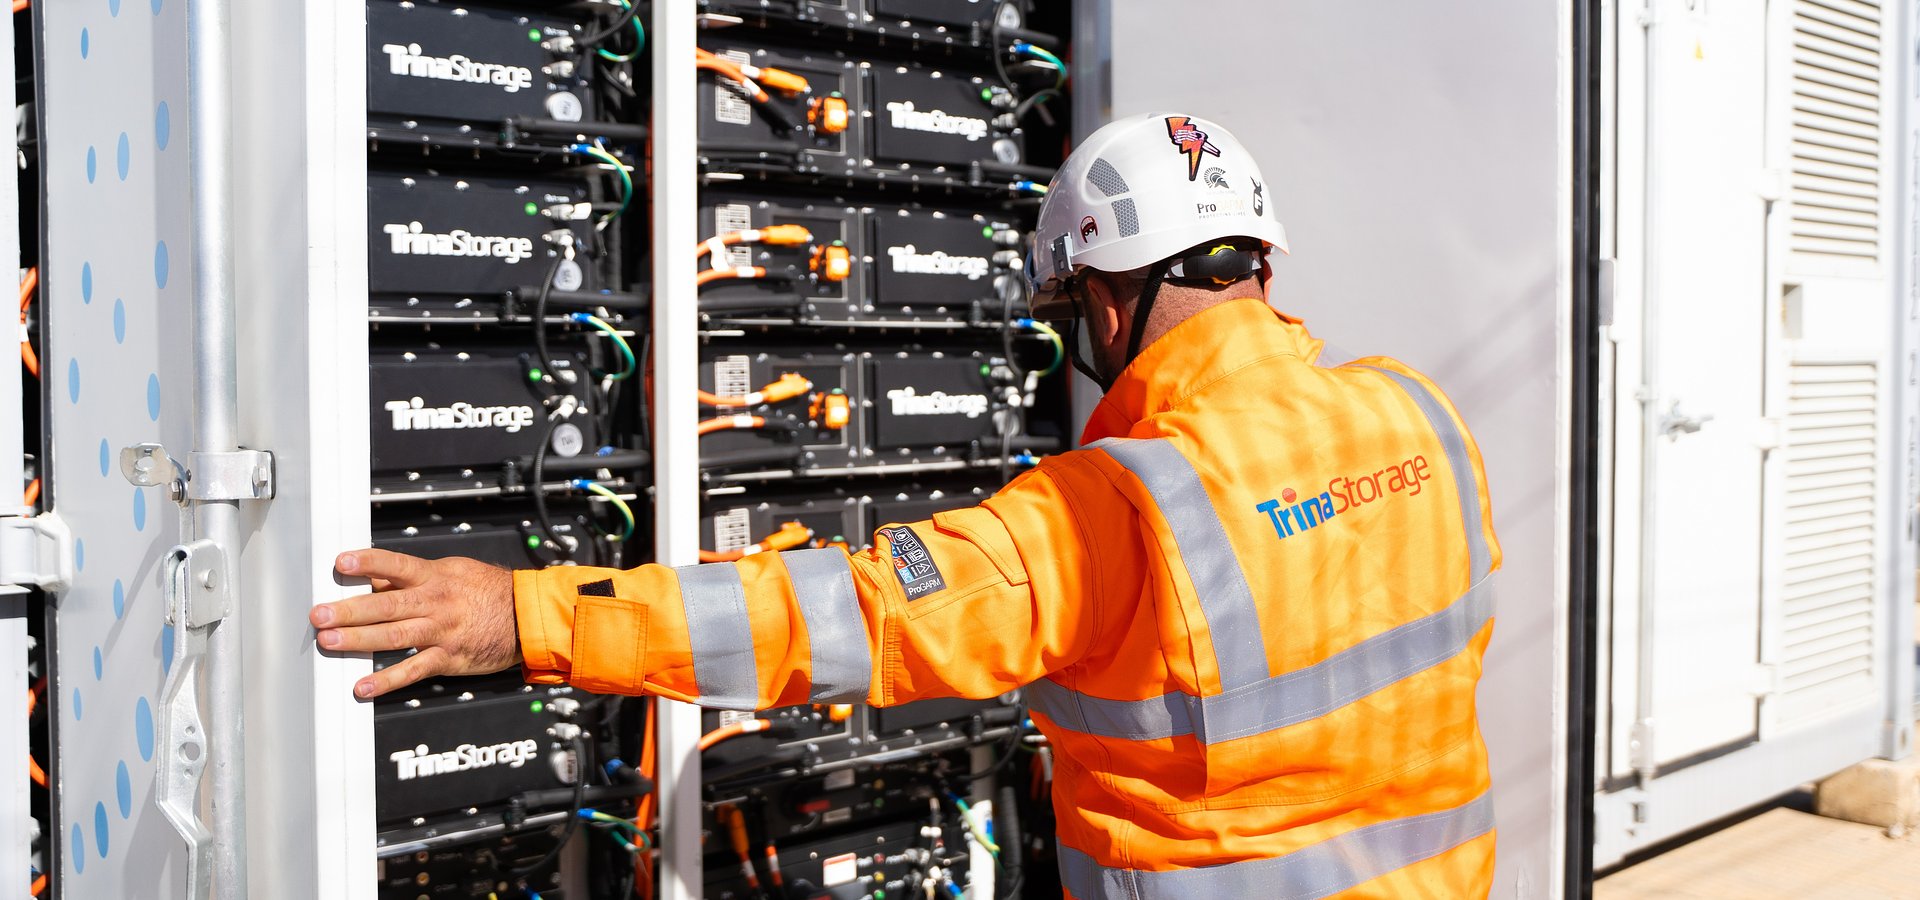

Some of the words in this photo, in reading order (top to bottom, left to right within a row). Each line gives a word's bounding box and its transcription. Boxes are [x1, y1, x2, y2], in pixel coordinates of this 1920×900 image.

[383, 43, 532, 92] TrinaStorage
[384, 221, 532, 263] TrinaStorage
[385, 396, 534, 434] TrinaStorage
[1256, 454, 1431, 540] TrinaStorage
[907, 577, 941, 595] ProGARM
[390, 739, 537, 781] TrinaStorage
